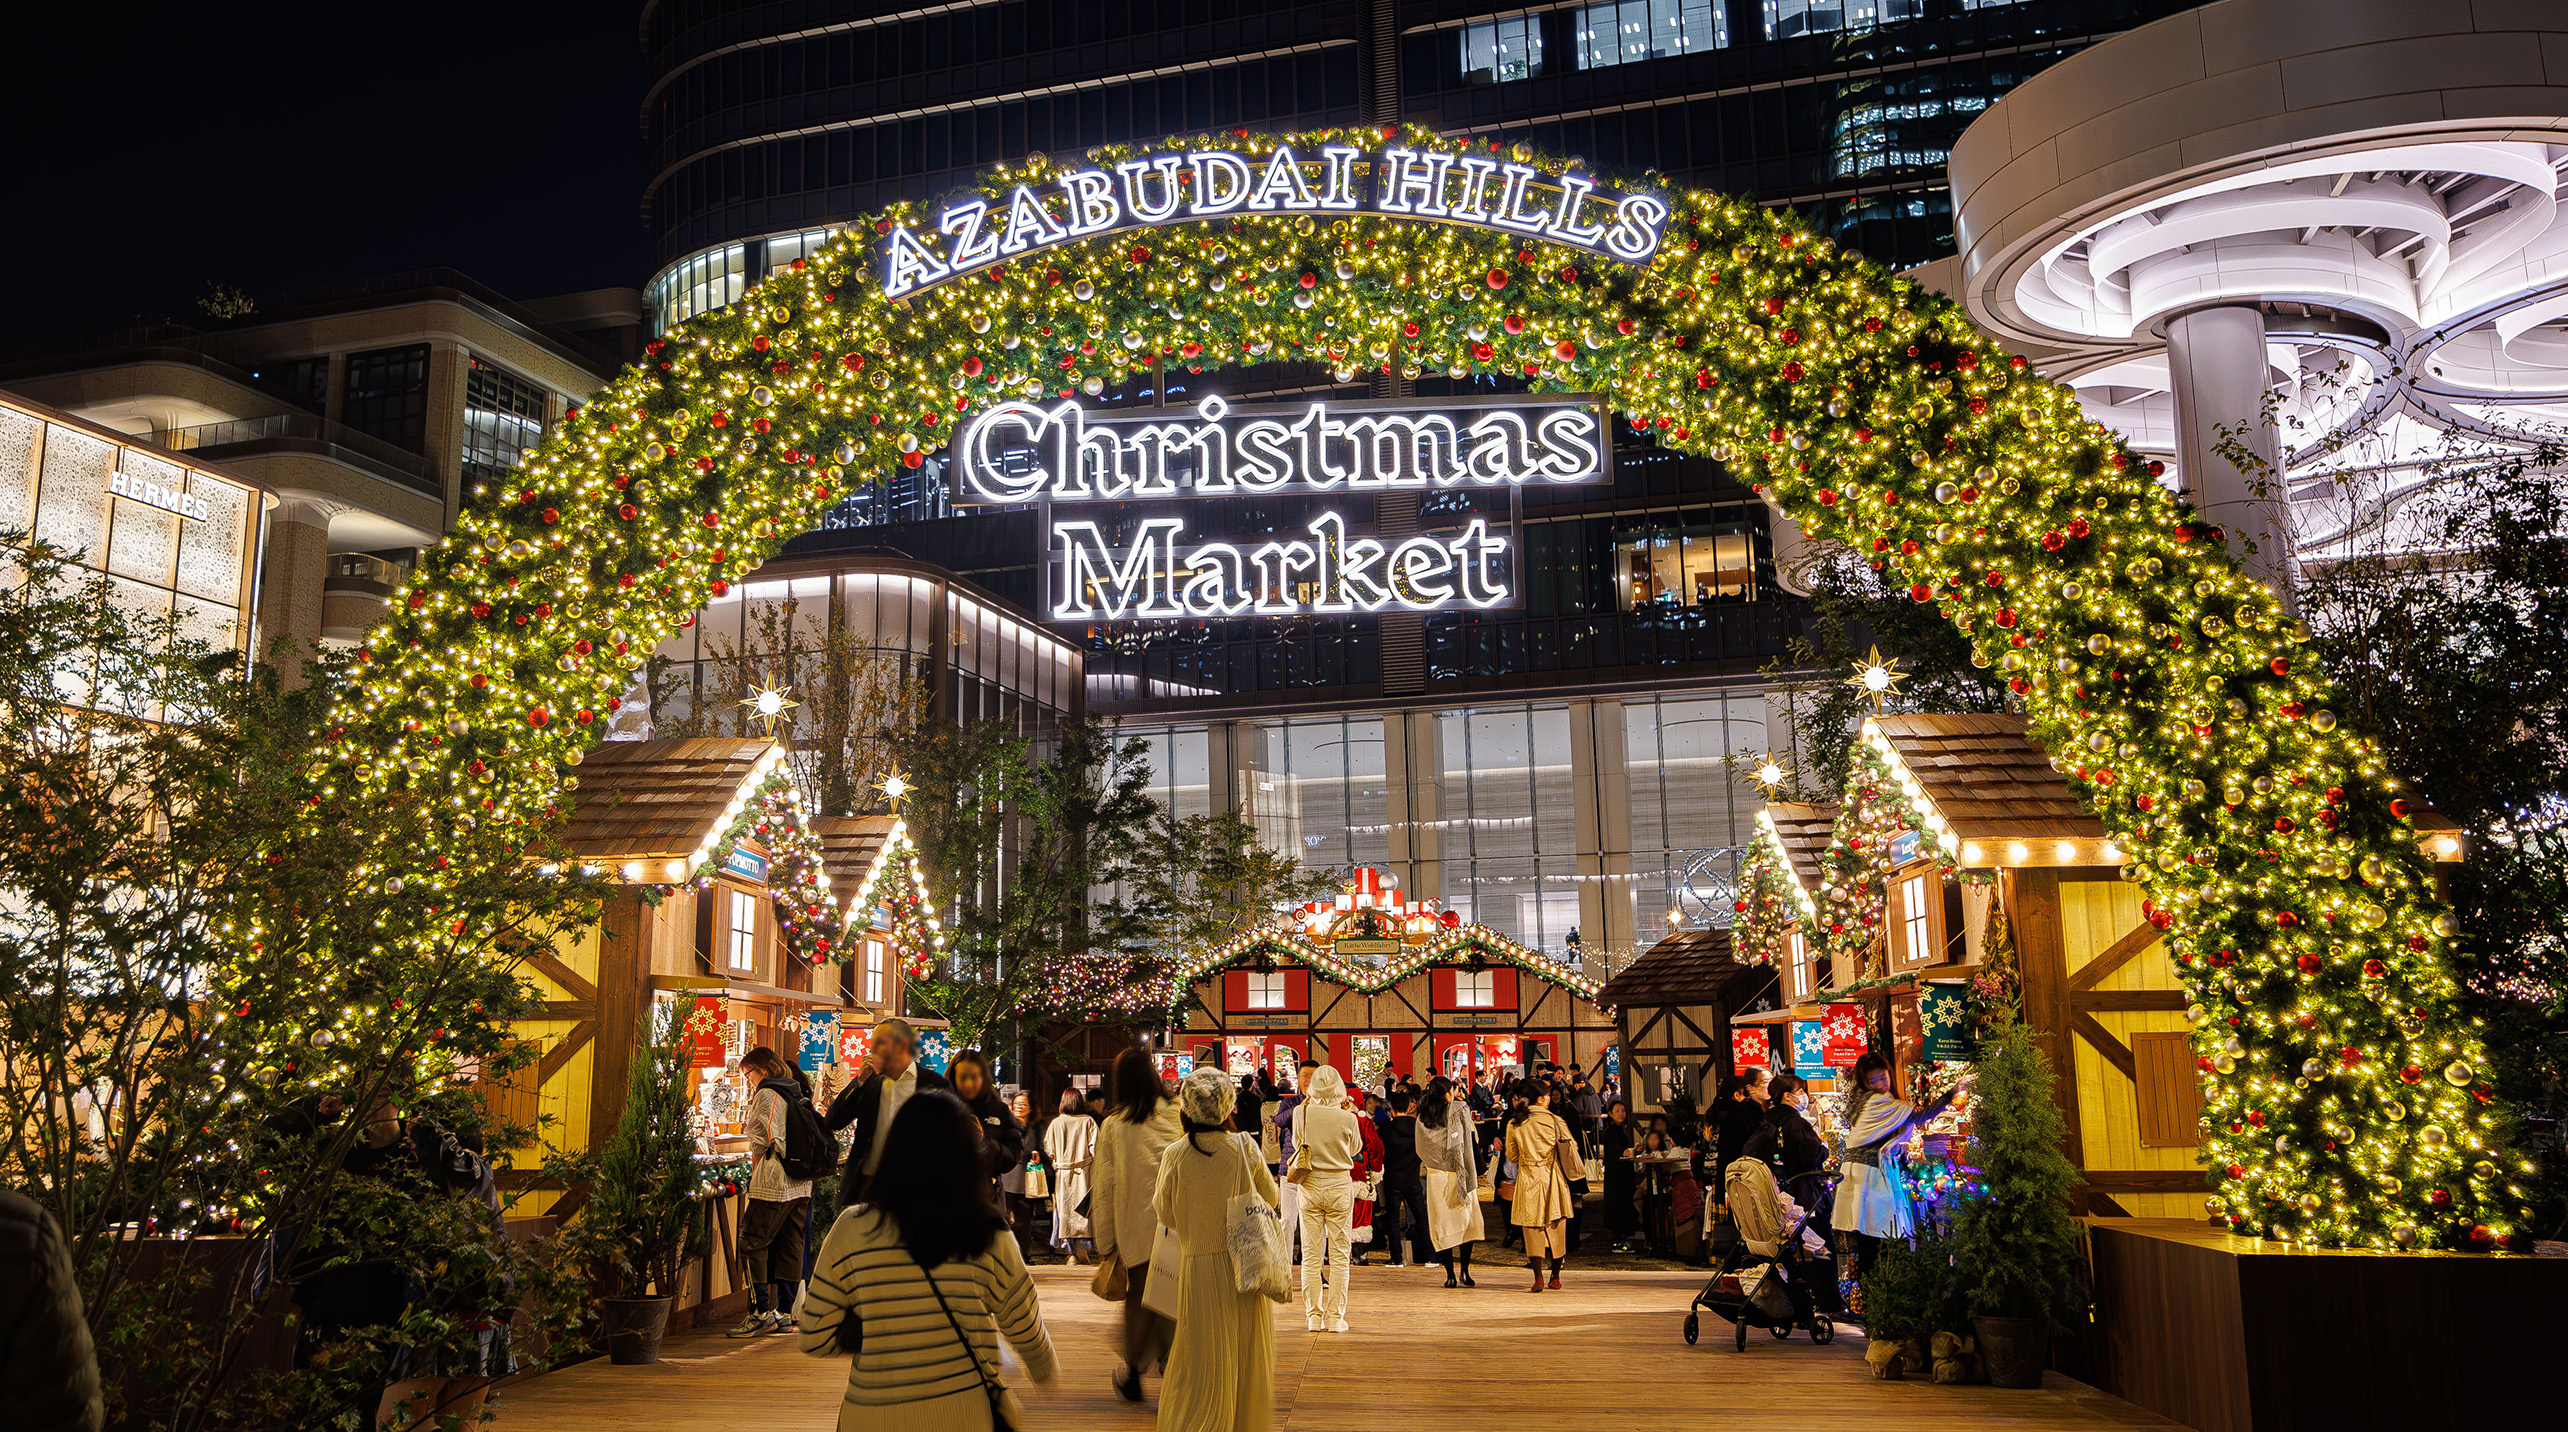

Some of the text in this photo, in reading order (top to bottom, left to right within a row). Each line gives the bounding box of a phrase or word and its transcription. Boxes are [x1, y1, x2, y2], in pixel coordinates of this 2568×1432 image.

[884, 146, 1668, 299] AZABUDAI HILLS
[109, 470, 208, 520] HERMÈS
[962, 396, 1600, 501] Christmas
[1053, 510, 1509, 620] Market
[728, 852, 760, 874] POPMOTTO
